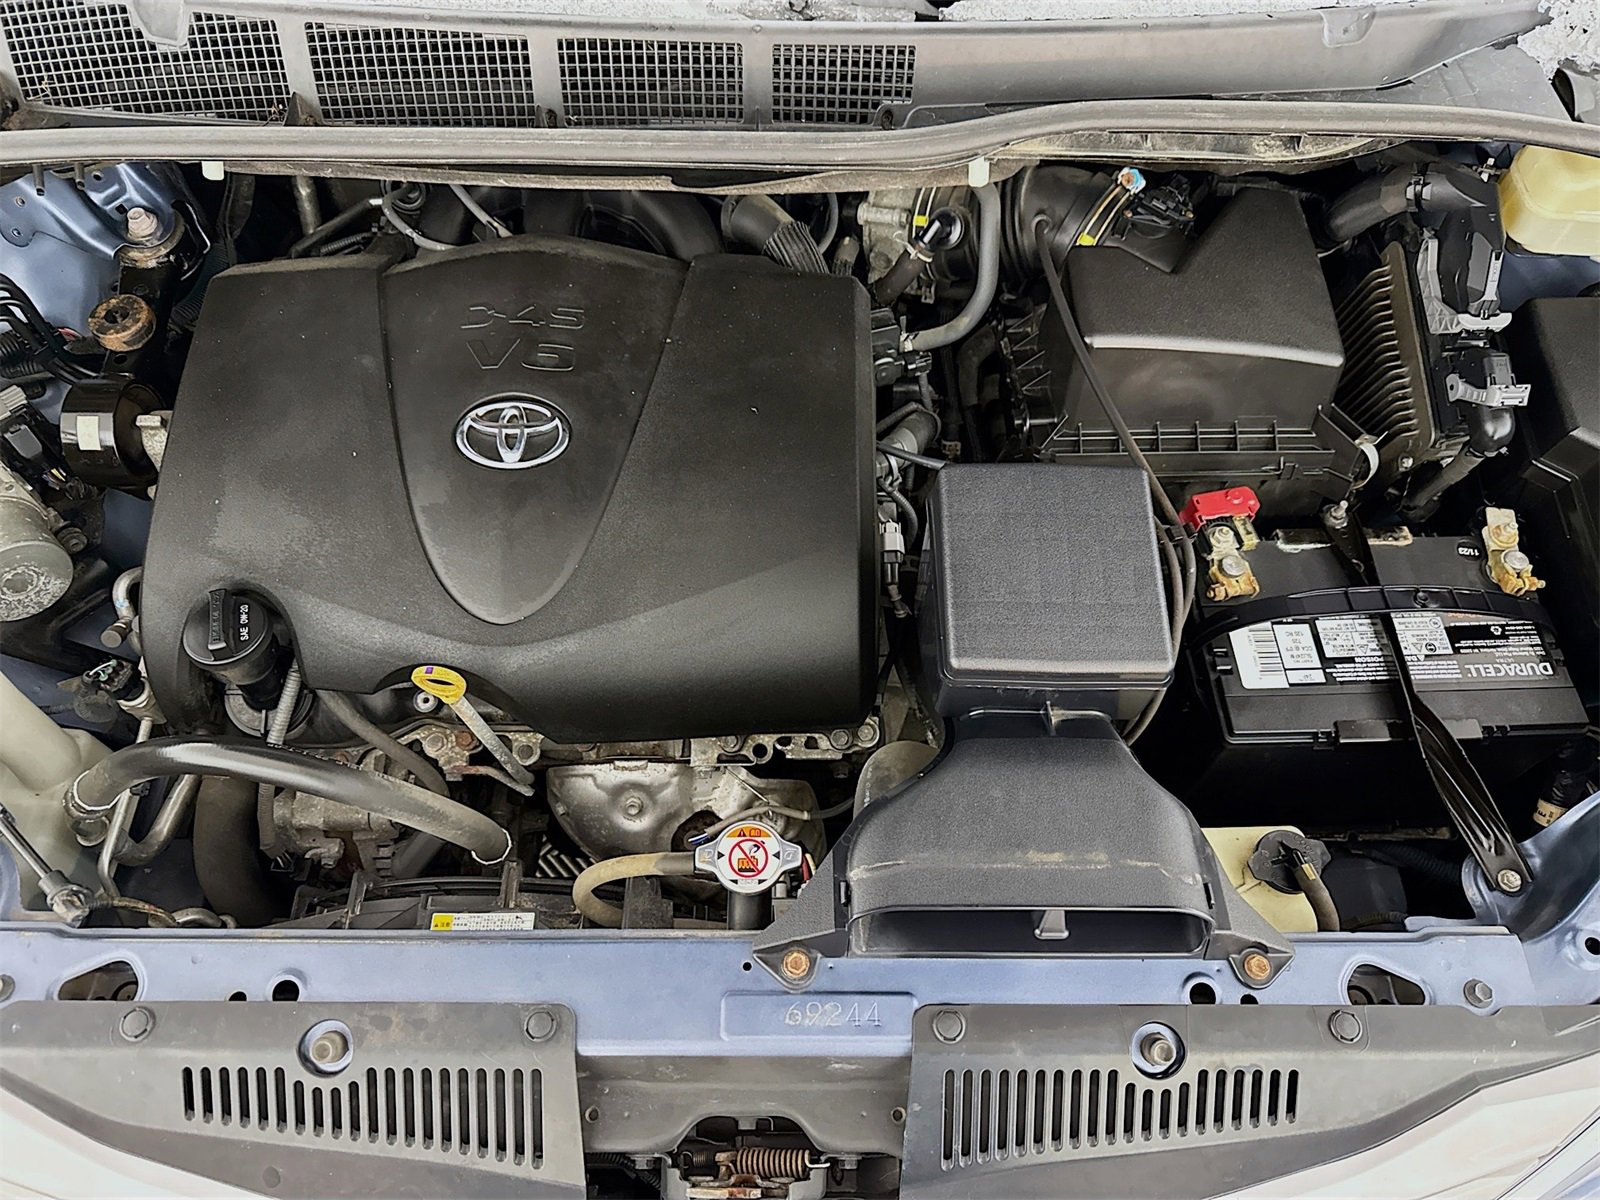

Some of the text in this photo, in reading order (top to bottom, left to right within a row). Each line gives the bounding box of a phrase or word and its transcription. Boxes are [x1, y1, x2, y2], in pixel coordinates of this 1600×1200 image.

[460, 304, 585, 330] D-4S
[465, 338, 576, 372] V6
[1458, 547, 1480, 556] 11/23
[240, 604, 249, 641] SAE 0W-20
[1465, 662, 1553, 677] DURACELL
[784, 1001, 882, 1027] 69244
